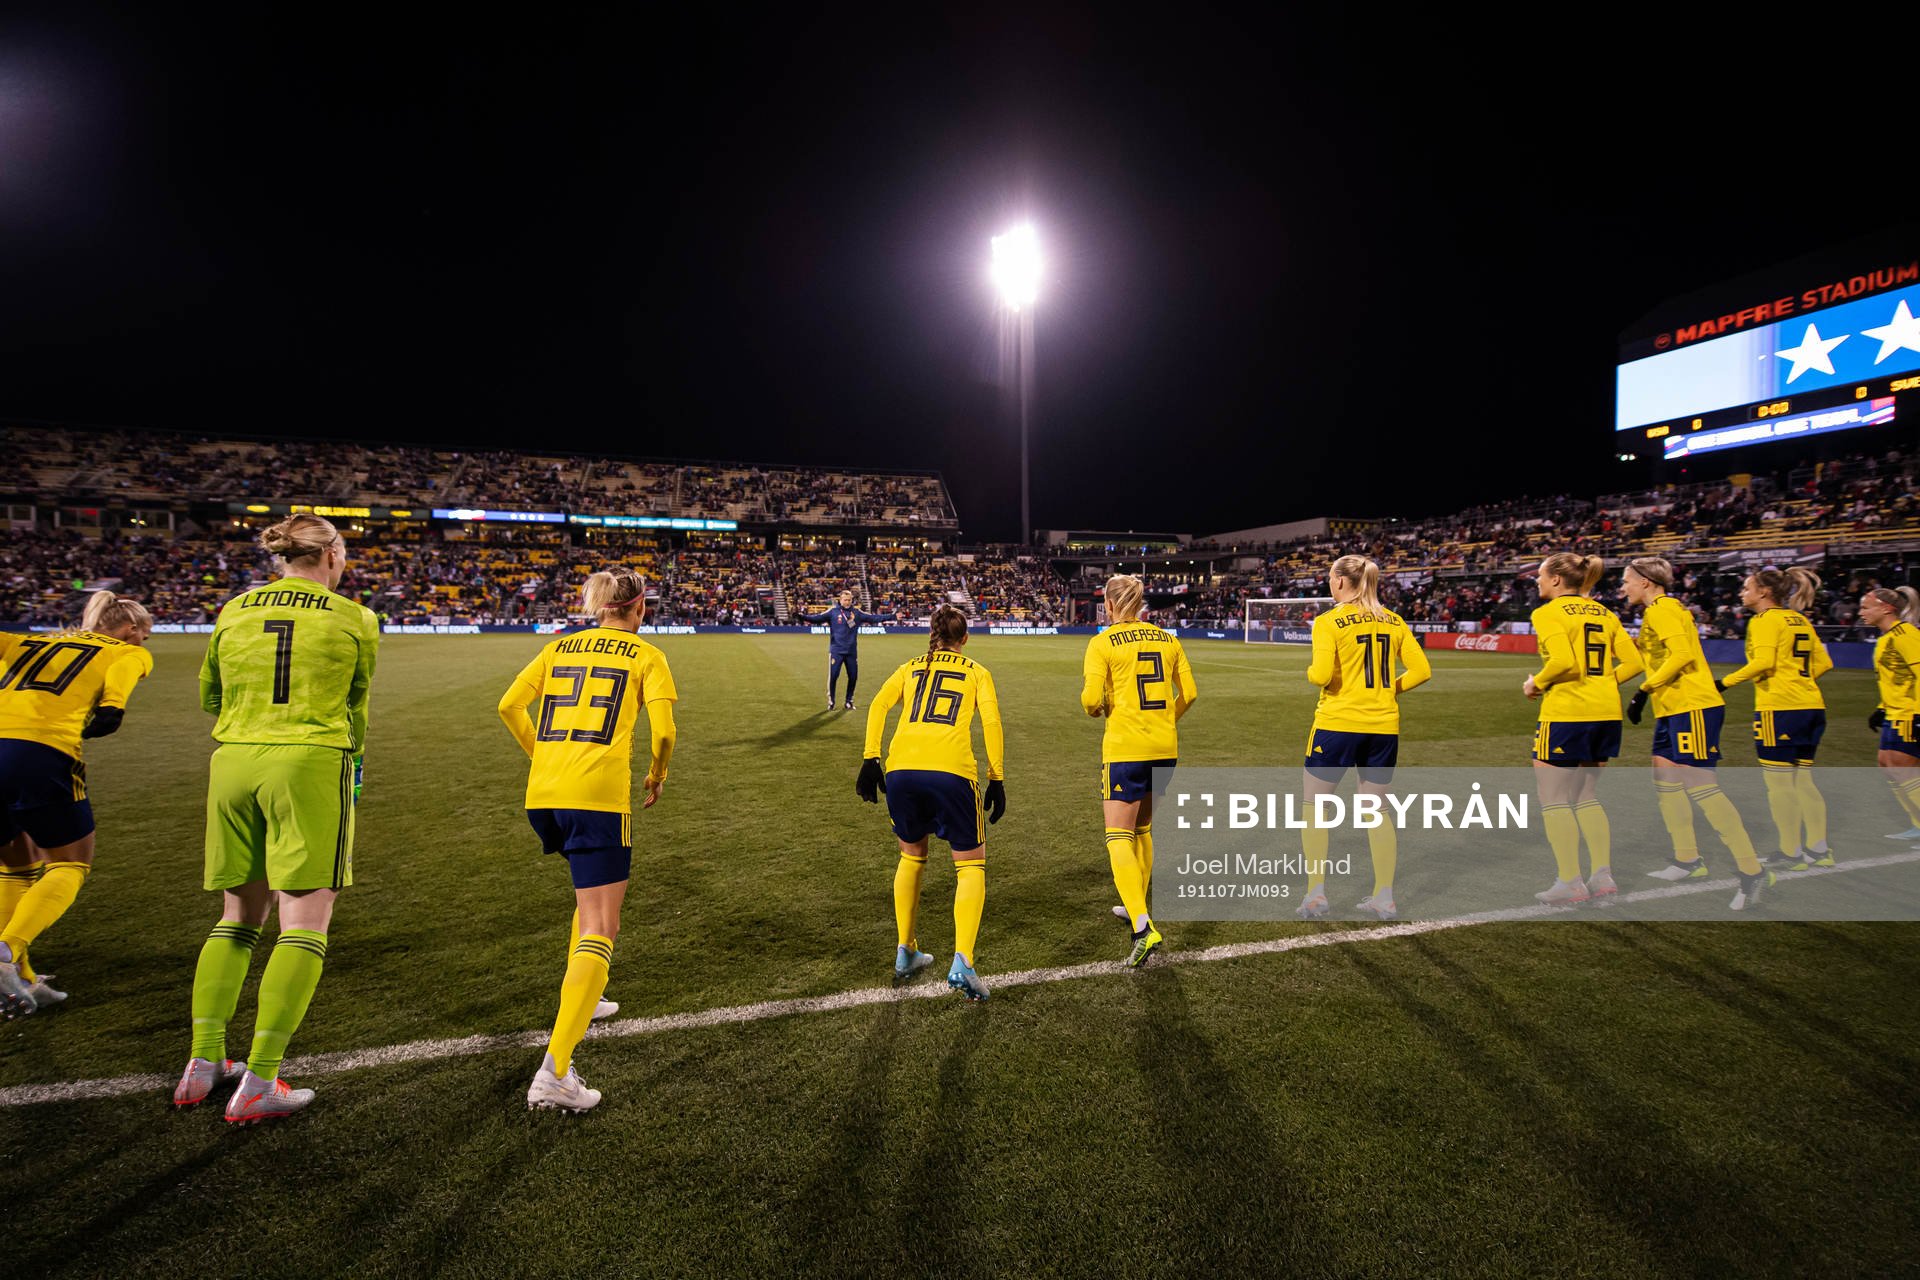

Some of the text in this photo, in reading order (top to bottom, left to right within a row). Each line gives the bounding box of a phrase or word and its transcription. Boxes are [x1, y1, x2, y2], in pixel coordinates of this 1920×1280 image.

[1675, 261, 1920, 345] MAPFRE STADIUM
[240, 589, 333, 611] LINDAHL
[555, 638, 641, 660] KULLBERG
[1108, 629, 1173, 647] ANDERSSON
[1283, 631, 1312, 641] Volkswa
[1432, 624, 1448, 632] TEA
[1583, 622, 1607, 676] 6
[0, 639, 103, 696] 10
[263, 619, 296, 705] 1
[1136, 651, 1167, 711] 2
[1356, 633, 1391, 689] 11
[1791, 633, 1811, 678] 5
[536, 666, 630, 746] 23
[909, 669, 967, 727] 16
[1676, 731, 1694, 754] 8
